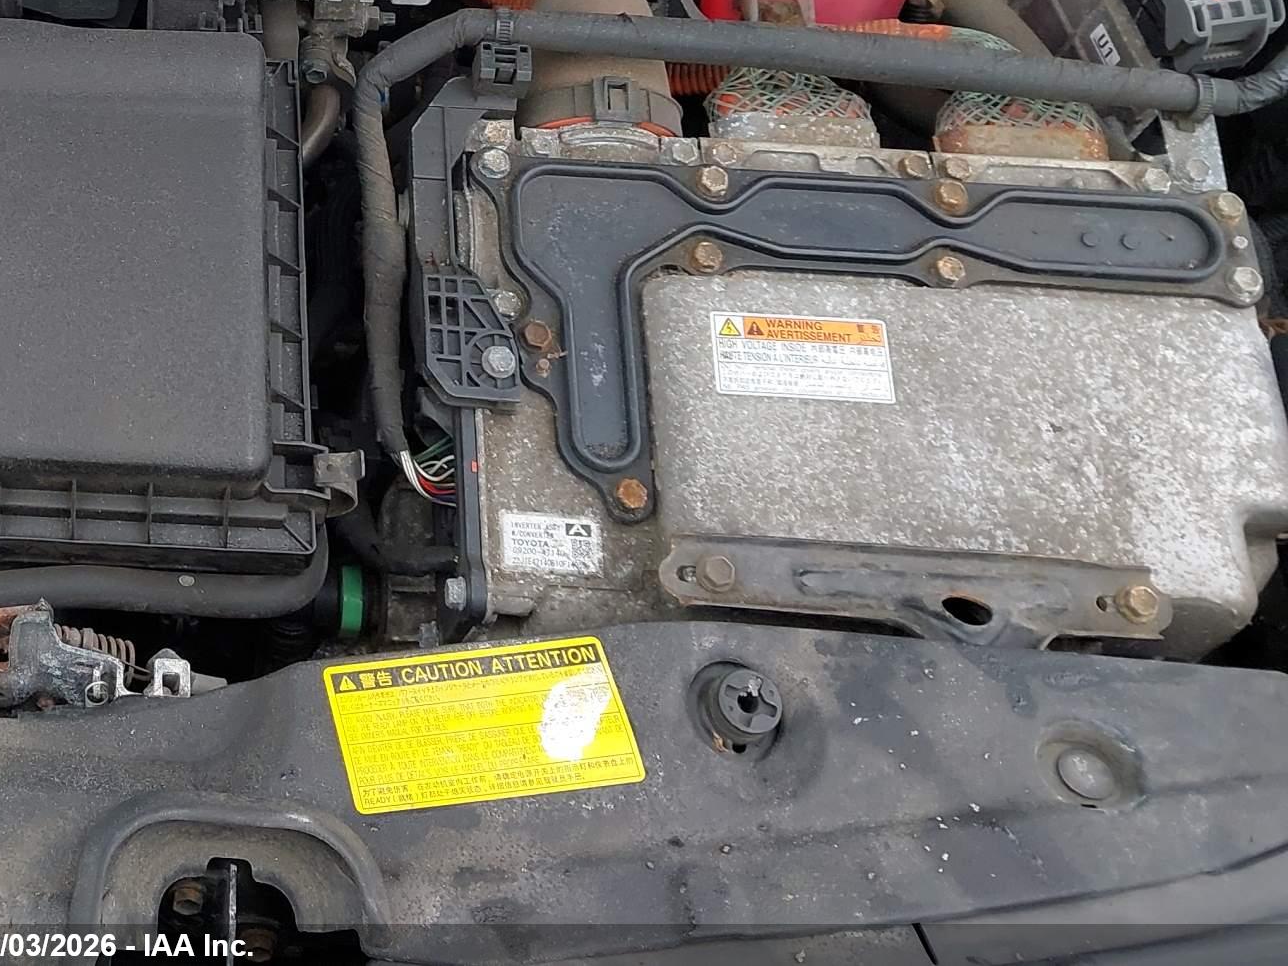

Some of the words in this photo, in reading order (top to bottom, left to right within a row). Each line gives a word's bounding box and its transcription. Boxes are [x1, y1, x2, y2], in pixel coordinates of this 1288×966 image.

[1097, 33, 1114, 59] U1
[766, 319, 823, 331] WARNING
[767, 331, 851, 342] AVERTISSEMENT
[719, 340, 737, 349] HIGH
[743, 341, 776, 351] VOLTAGE
[782, 343, 807, 352] INSIDE
[743, 352, 772, 362] TENSION
[568, 524, 588, 536] A
[512, 538, 550, 547] TOYOTA
[359, 667, 393, 689] 警告
[401, 659, 483, 685] CAUTION
[492, 646, 597, 673] ATTENTION
